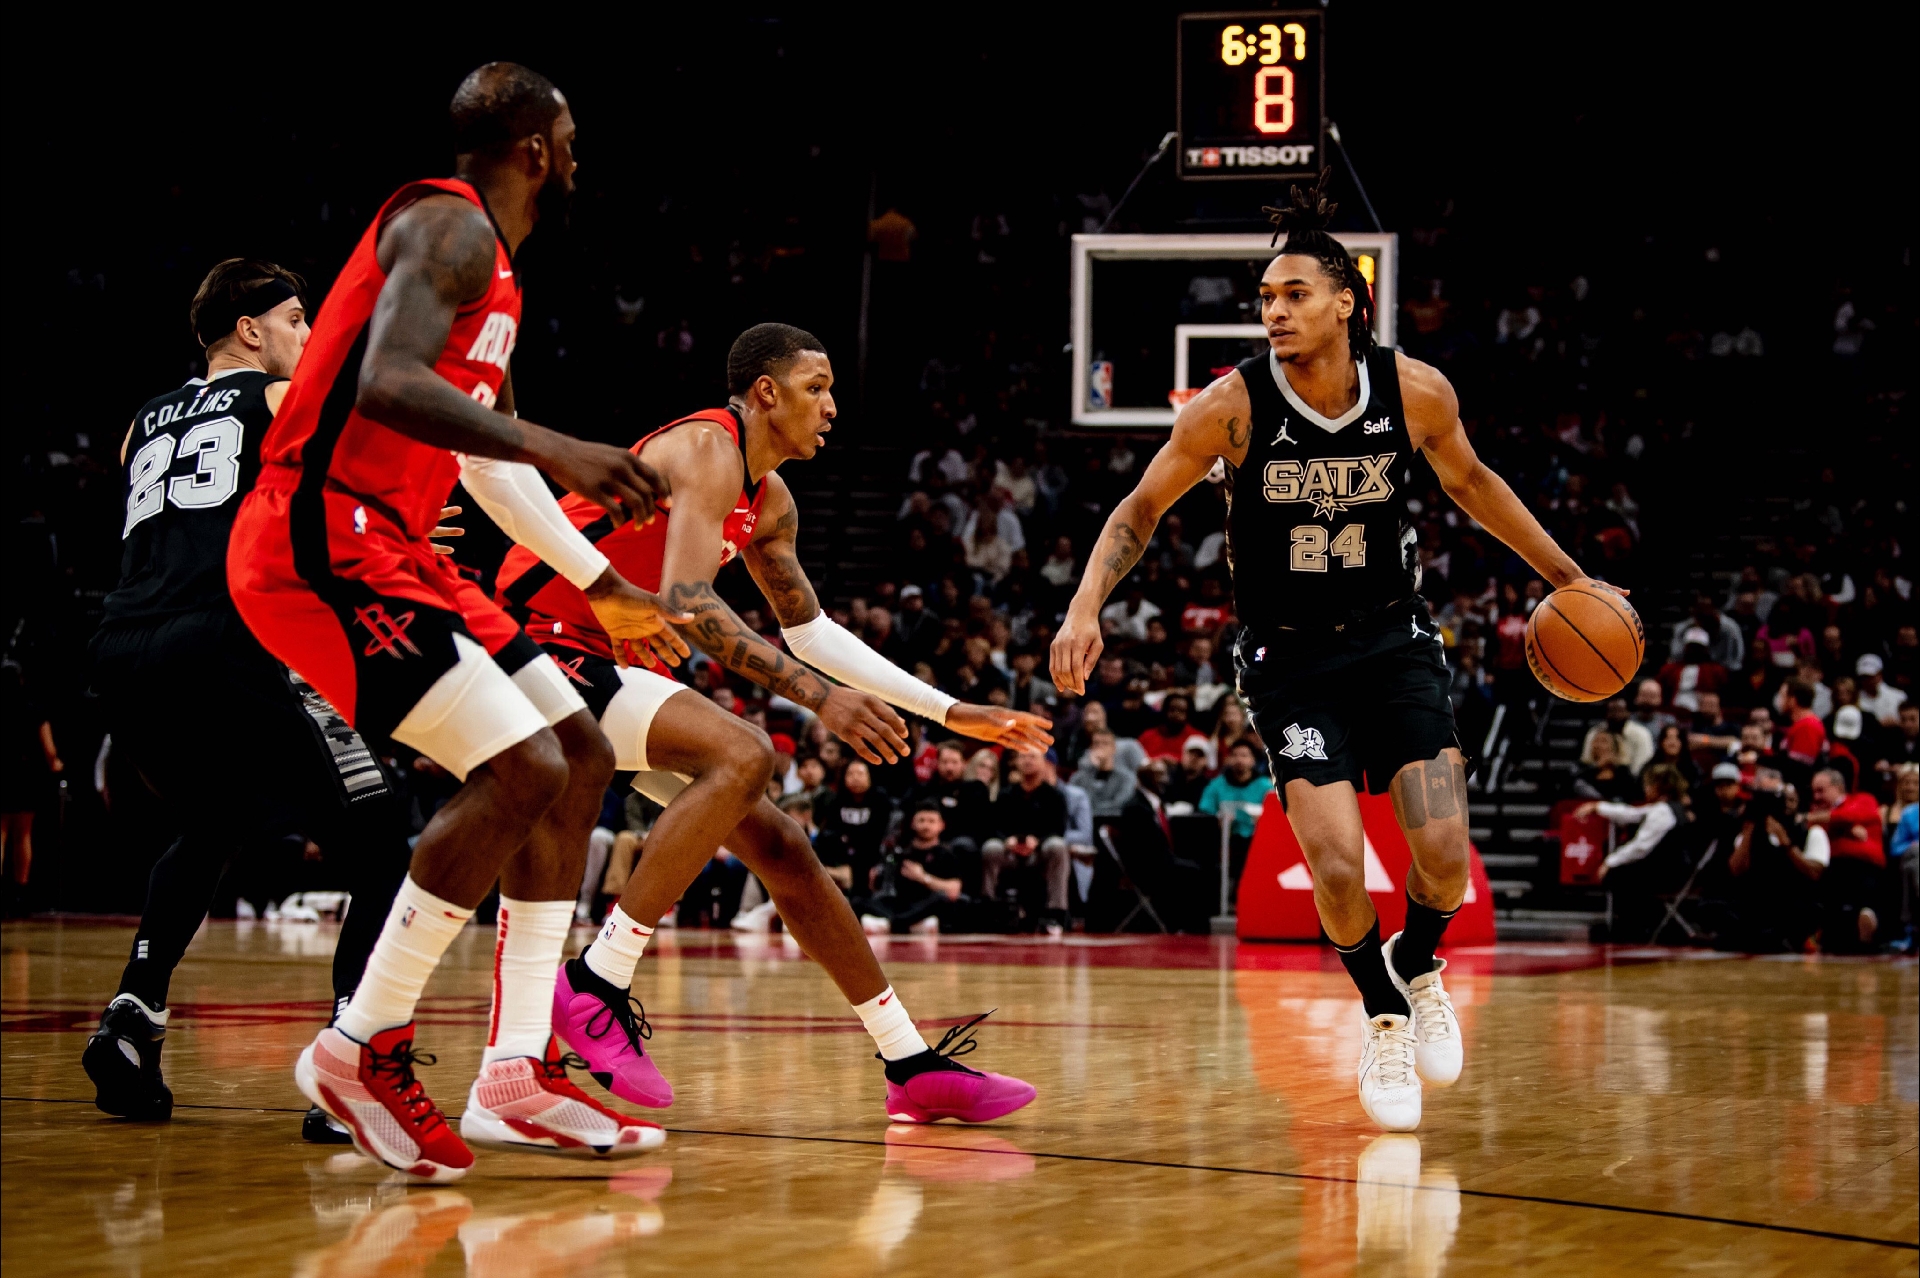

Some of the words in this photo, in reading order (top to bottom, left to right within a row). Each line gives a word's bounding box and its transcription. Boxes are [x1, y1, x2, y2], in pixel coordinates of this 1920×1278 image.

[1221, 24, 1306, 66] 6:37
[1254, 66, 1294, 133] 8
[1220, 145, 1314, 167] TISSOT
[143, 388, 241, 437] COLLINS
[122, 415, 245, 541] 23
[1263, 452, 1398, 508] SATX
[1290, 523, 1367, 573] 24
